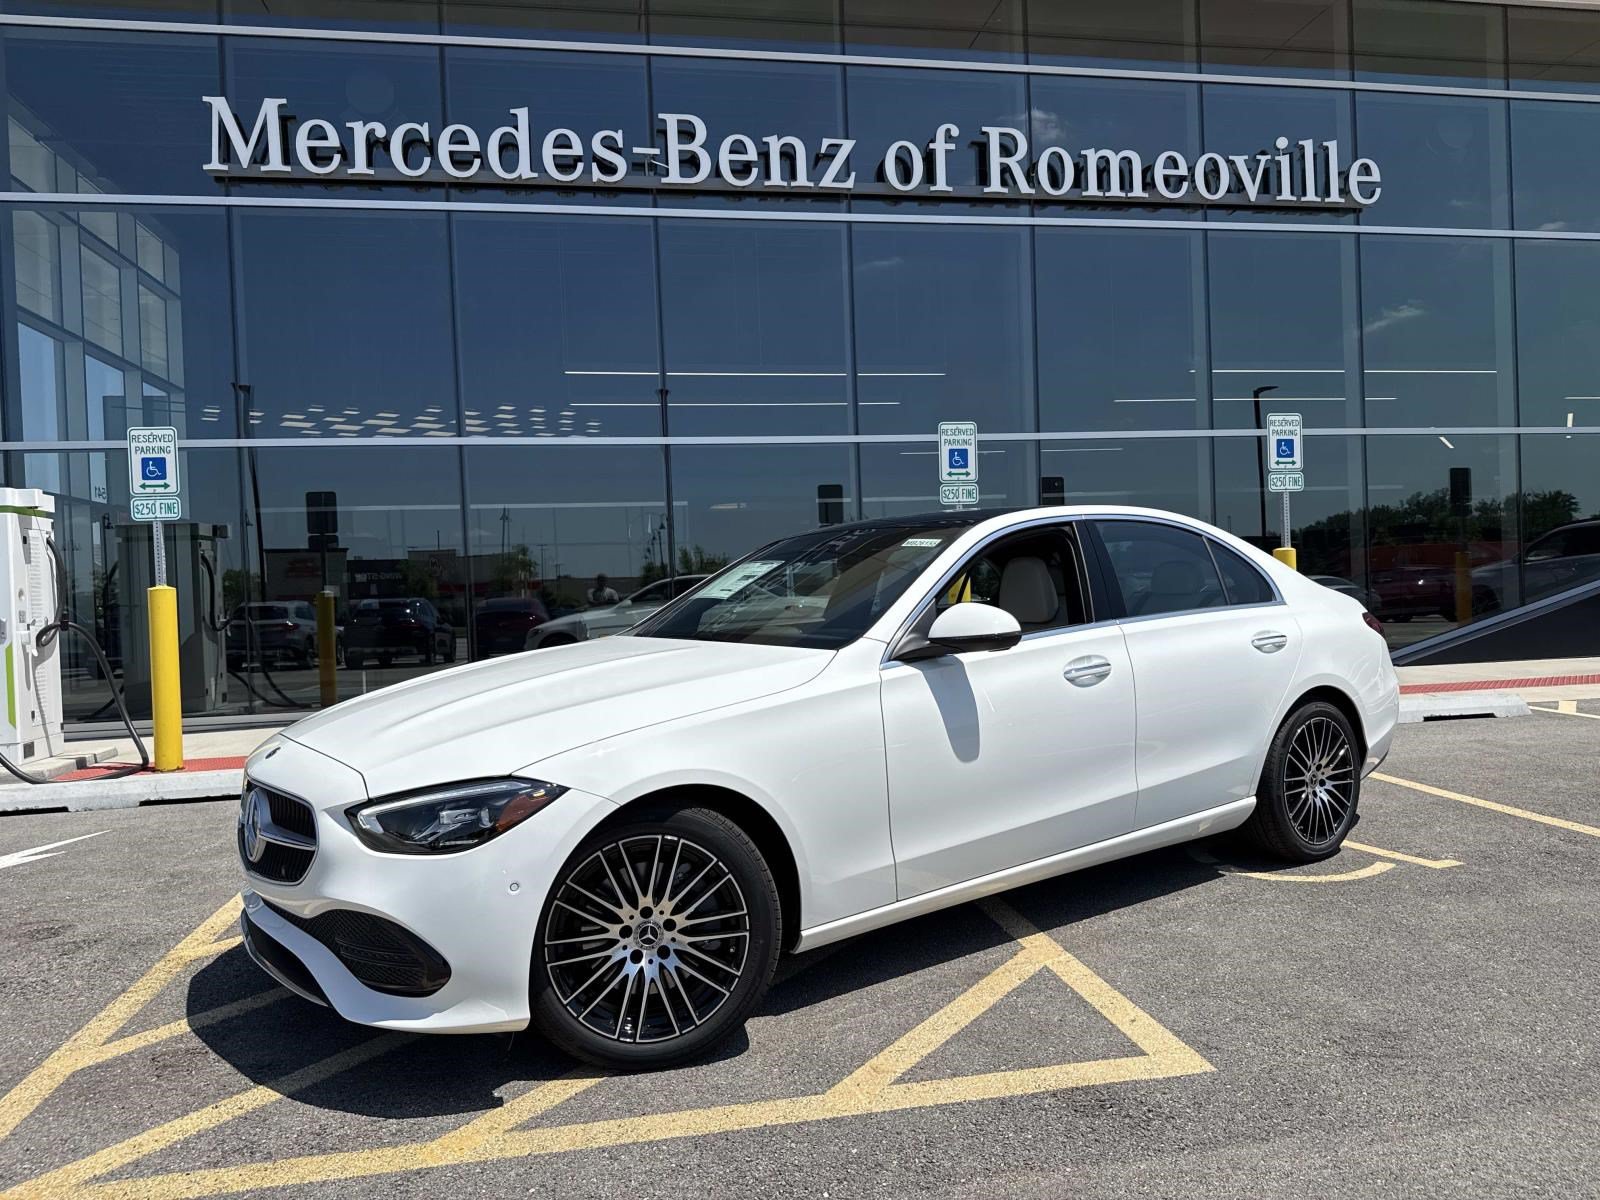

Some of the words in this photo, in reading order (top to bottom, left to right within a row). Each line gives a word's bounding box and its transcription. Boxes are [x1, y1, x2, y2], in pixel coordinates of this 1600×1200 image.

[202, 95, 857, 189] Mercedes-Benz
[884, 123, 960, 192] of
[981, 126, 1382, 205] Romeoville
[1269, 419, 1300, 427] RESERVED
[941, 428, 974, 436] RESERVED
[1271, 429, 1298, 437] PARKING
[131, 434, 174, 443] RESERVED
[943, 438, 972, 446] PARKING
[134, 445, 171, 454] PARKING
[1271, 476, 1287, 488] $250
[1288, 476, 1302, 486] FINE
[942, 488, 959, 500] $250
[961, 488, 975, 499] FINE
[134, 503, 156, 515] $250
[159, 502, 177, 514] FINE
